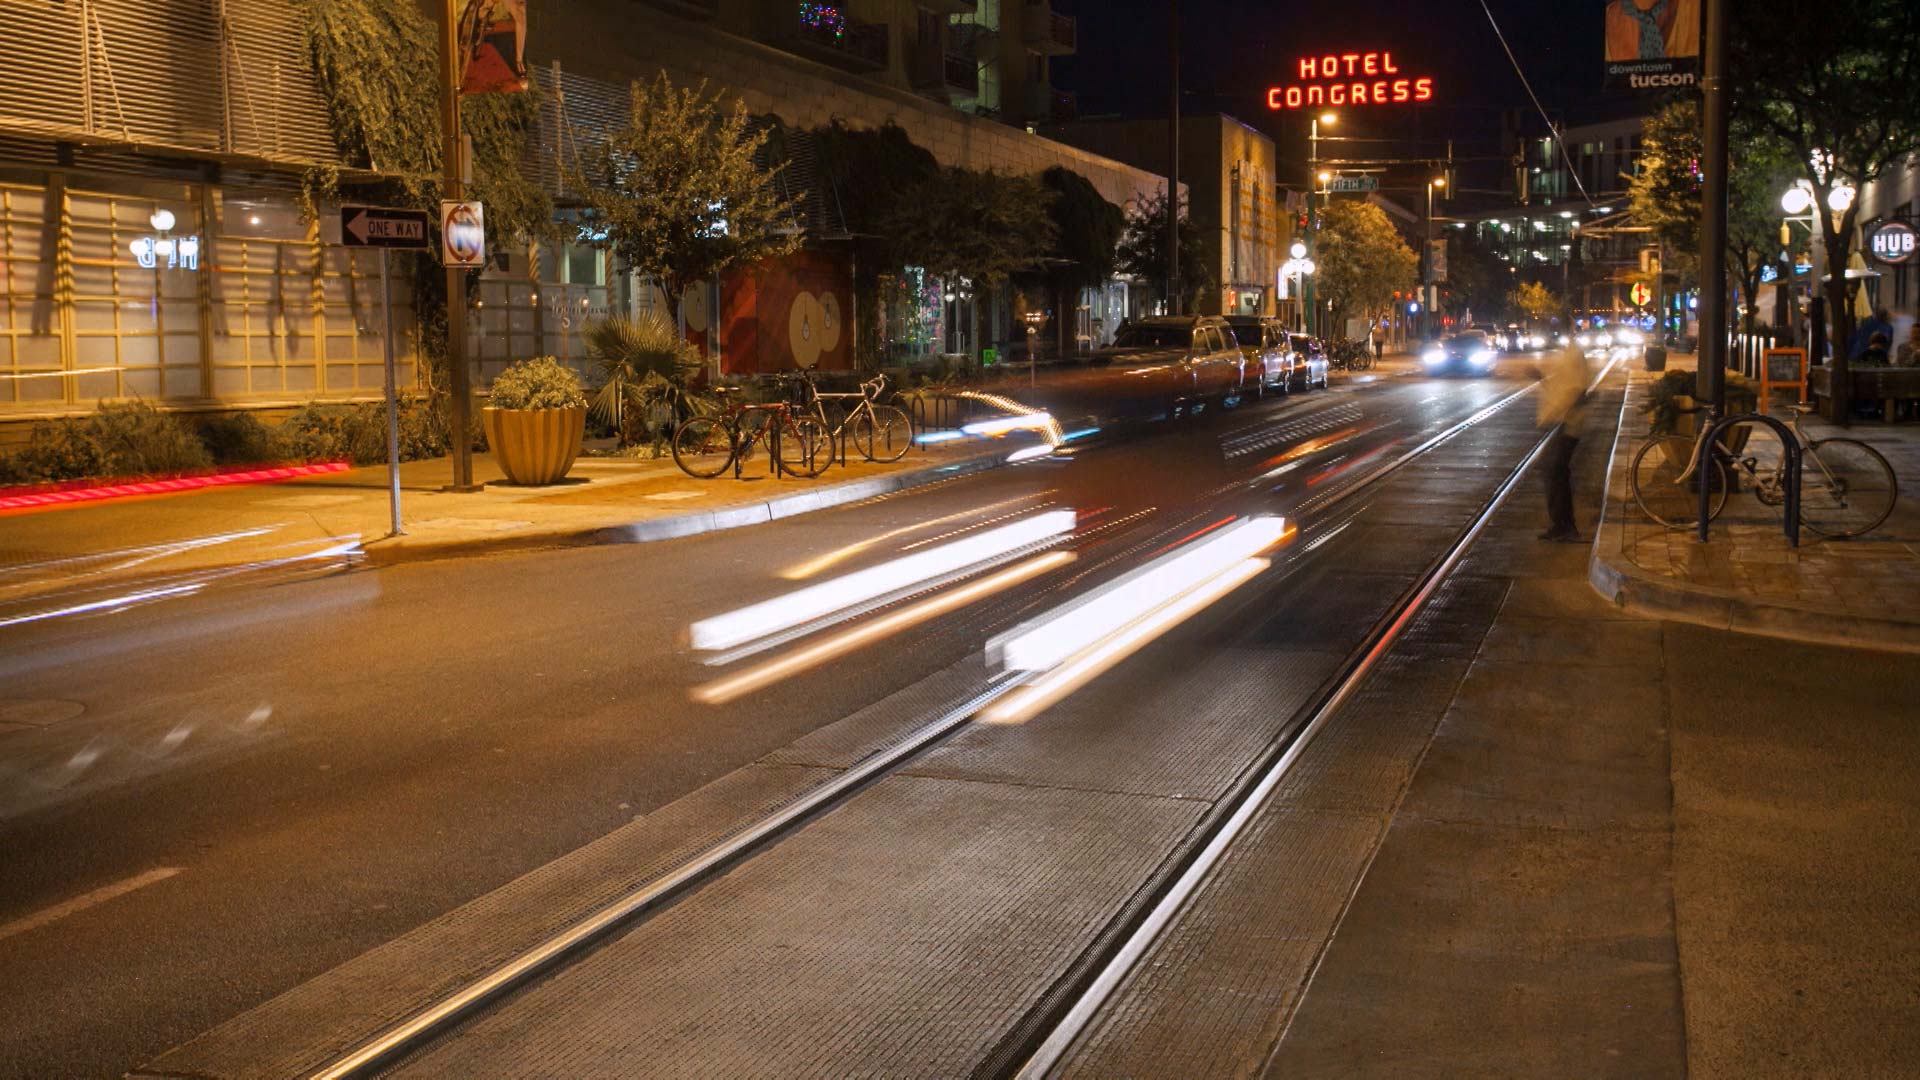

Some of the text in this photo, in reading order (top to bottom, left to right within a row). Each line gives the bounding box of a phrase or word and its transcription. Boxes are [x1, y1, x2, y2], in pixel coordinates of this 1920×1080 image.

[1300, 52, 1397, 78] HOTEL
[1609, 63, 1672, 74] downtown
[1630, 73, 1694, 88] tucson
[1268, 78, 1431, 108] CONGRESS
[1333, 178, 1359, 191] FIFTH
[368, 221, 419, 237] ONE WAY
[1873, 233, 1915, 252] HUB
